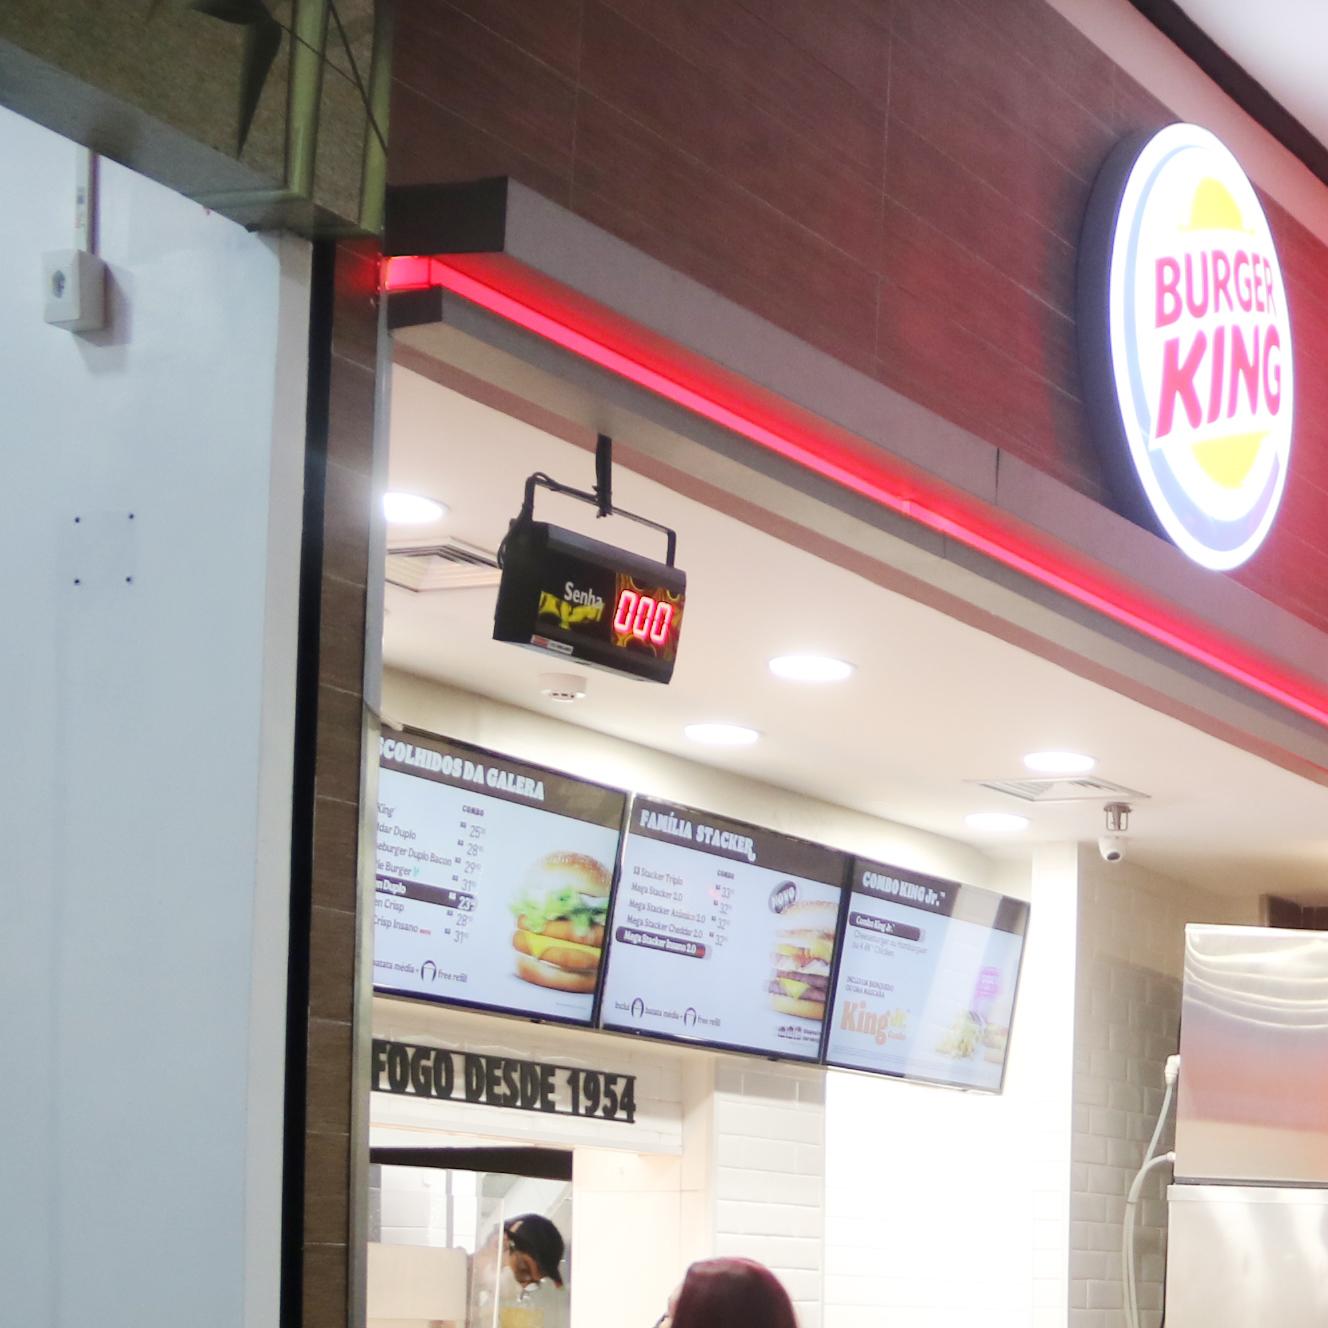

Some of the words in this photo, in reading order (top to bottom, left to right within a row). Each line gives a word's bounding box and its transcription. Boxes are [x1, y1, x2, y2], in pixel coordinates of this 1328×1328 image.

[1152, 249, 1277, 329] BURGER
[1154, 325, 1282, 440] KING
[564, 582, 603, 609] Senha
[613, 589, 673, 644] 000
[463, 761, 486, 785] DA
[487, 768, 545, 801] GALERA
[393, 826, 416, 840] Duplo
[639, 809, 693, 843] FAMÍLIA
[696, 824, 756, 863] STACKER
[862, 871, 899, 895] COMBO
[899, 880, 925, 902] KING
[371, 1040, 454, 1099] FOGO
[464, 1054, 556, 1112] DESDE
[567, 1068, 637, 1123] 1954
